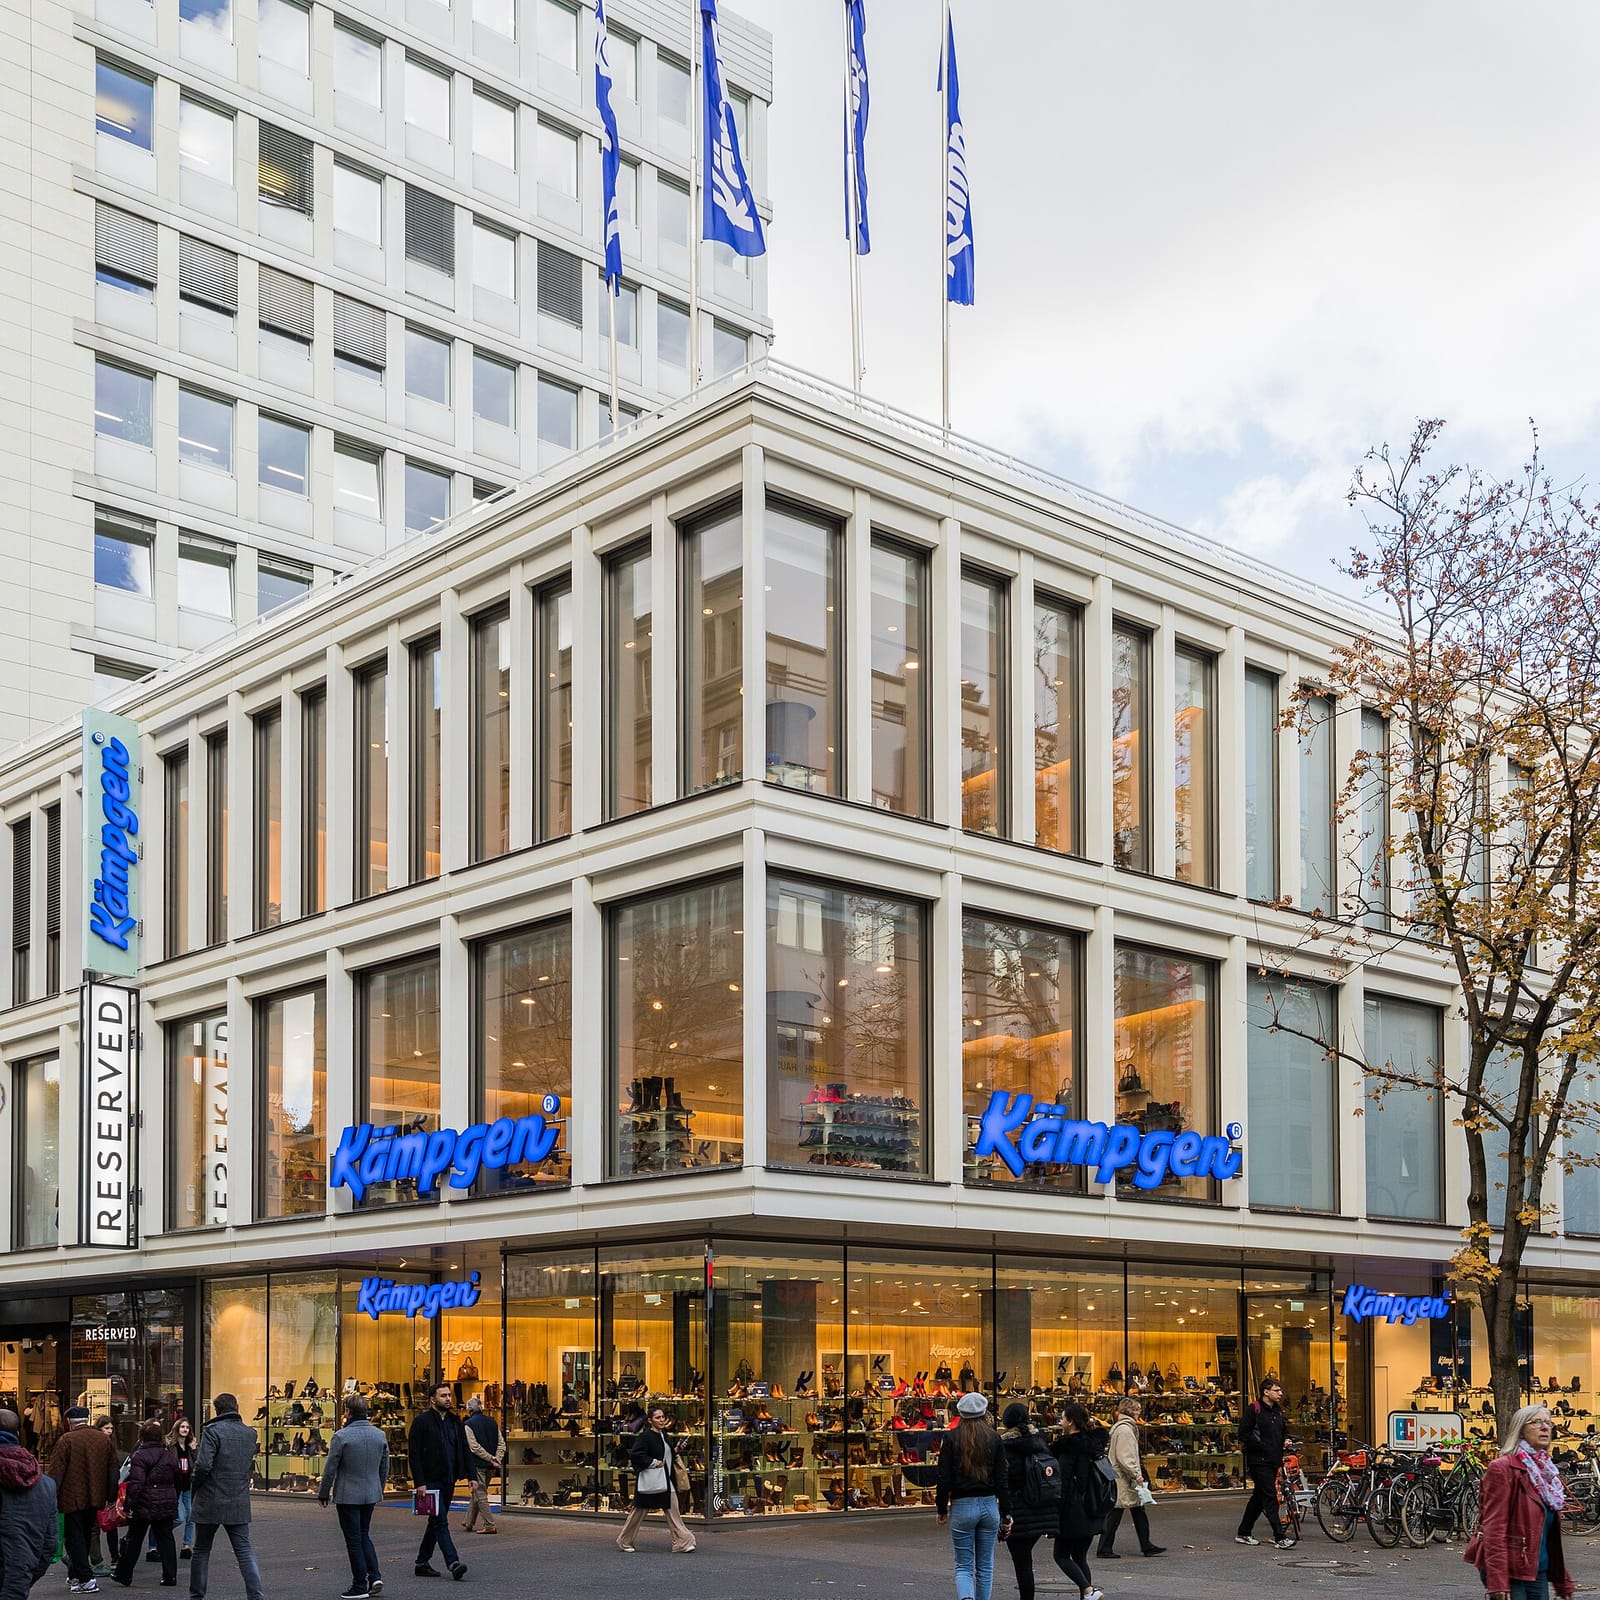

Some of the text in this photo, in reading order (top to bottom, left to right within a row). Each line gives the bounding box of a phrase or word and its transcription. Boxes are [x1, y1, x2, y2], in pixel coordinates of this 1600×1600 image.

[90, 736, 139, 951] Kämpgen
[97, 1001, 123, 1232] RESERVED
[330, 1114, 560, 1201] Kämpgen
[974, 1090, 1242, 1190] Kämpgen
[85, 1327, 137, 1341] RESERVED
[357, 1274, 481, 1320] Kämpgen
[1342, 1284, 1450, 1326] Kämpgen
